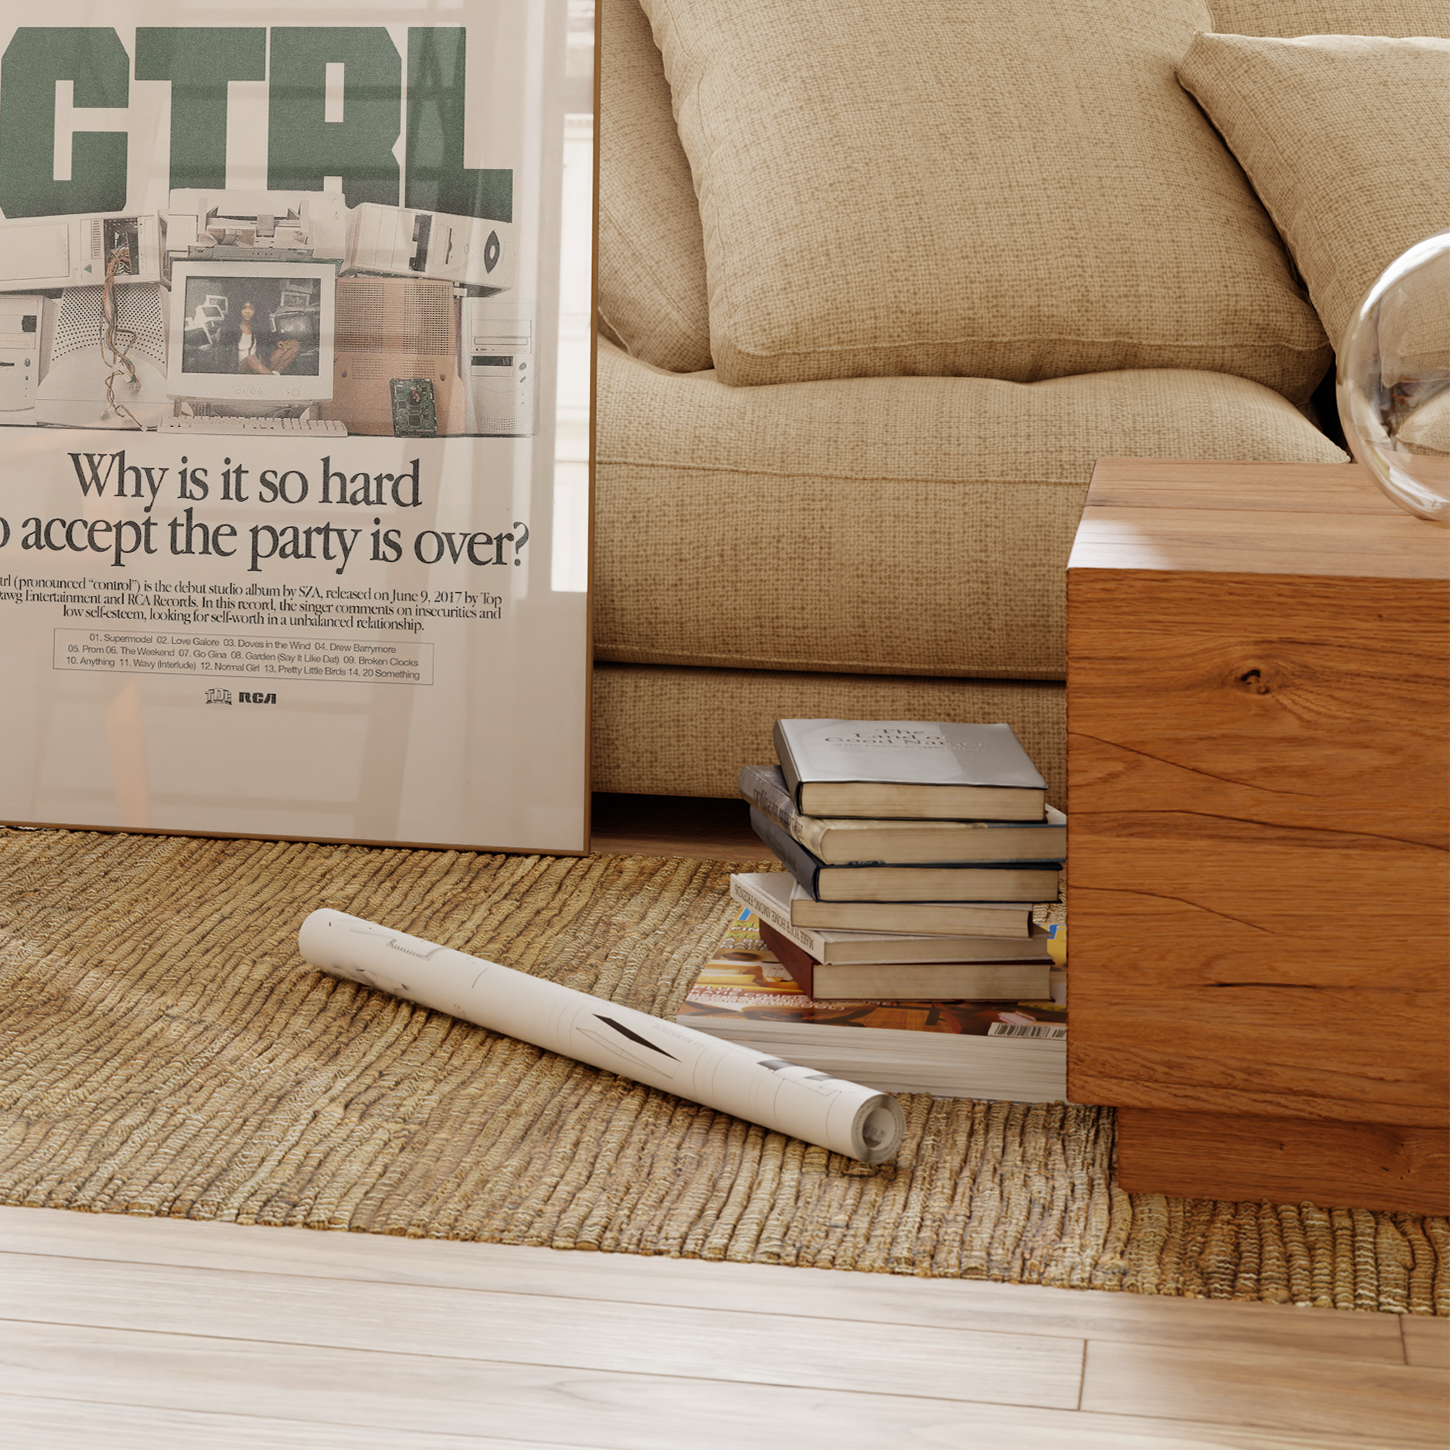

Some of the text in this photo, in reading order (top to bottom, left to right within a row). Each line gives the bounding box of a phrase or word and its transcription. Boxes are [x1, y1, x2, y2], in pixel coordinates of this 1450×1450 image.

[67, 450, 422, 512] Why is it so hard
[21, 510, 156, 567] accept
[169, 507, 237, 558] the
[248, 519, 363, 574] party
[370, 518, 404, 563] is
[413, 521, 531, 567] over?
[14, 576, 86, 591] (pronounced
[144, 581, 152, 591] is
[155, 581, 171, 593] the
[174, 581, 206, 593] debut
[209, 583, 242, 595] studio
[245, 584, 280, 596] album
[283, 585, 297, 600] by
[299, 586, 323, 599] SZA,
[326, 587, 371, 600] released
[374, 591, 389, 600] on
[390, 589, 418, 604] June
[421, 590, 430, 603] 9,
[434, 591, 462, 603] 2017
[465, 591, 478, 608] by
[480, 592, 502, 608] Top
[26, 590, 101, 604] Entertainment
[103, 592, 124, 605] and
[128, 593, 150, 605] RCA
[153, 595, 198, 608] Records.
[202, 596, 213, 608] In
[216, 596, 235, 609] this
[238, 599, 275, 612] record,
[279, 599, 297, 611] the
[300, 601, 333, 615] singer
[336, 603, 394, 615] comments
[397, 606, 412, 616] on
[416, 605, 476, 618] insecurities
[479, 608, 501, 619] and
[63, 605, 424, 633] low self-esteem, looking for self-worth in a unbalanced relationship.
[68, 645, 80, 653] 05.
[82, 645, 104, 654] Prom
[106, 646, 118, 654] 06.
[120, 647, 136, 655] The
[137, 647, 175, 657] Weekend
[179, 649, 191, 657] 07.
[193, 650, 206, 658] Go
[208, 650, 227, 659] Gina
[231, 651, 243, 659] 08.
[245, 652, 275, 661] Garden
[277, 653, 295, 663] (Say
[297, 654, 302, 662] It
[323, 655, 340, 664] Dat)
[343, 656, 356, 664] 09.
[359, 657, 388, 665] Broken
[390, 658, 418, 666] Clocks
[89, 633, 396, 654] 01. Supermodel 02. Love Galore 03. Doves in the Wind 04. Drew Barrymore
[67, 657, 420, 680] 10. Anything 11. Wavy (Interlude) 12. Normal Girl 13. Pretty Little Birds 14. 20 Something
[239, 692, 277, 704] RCA
